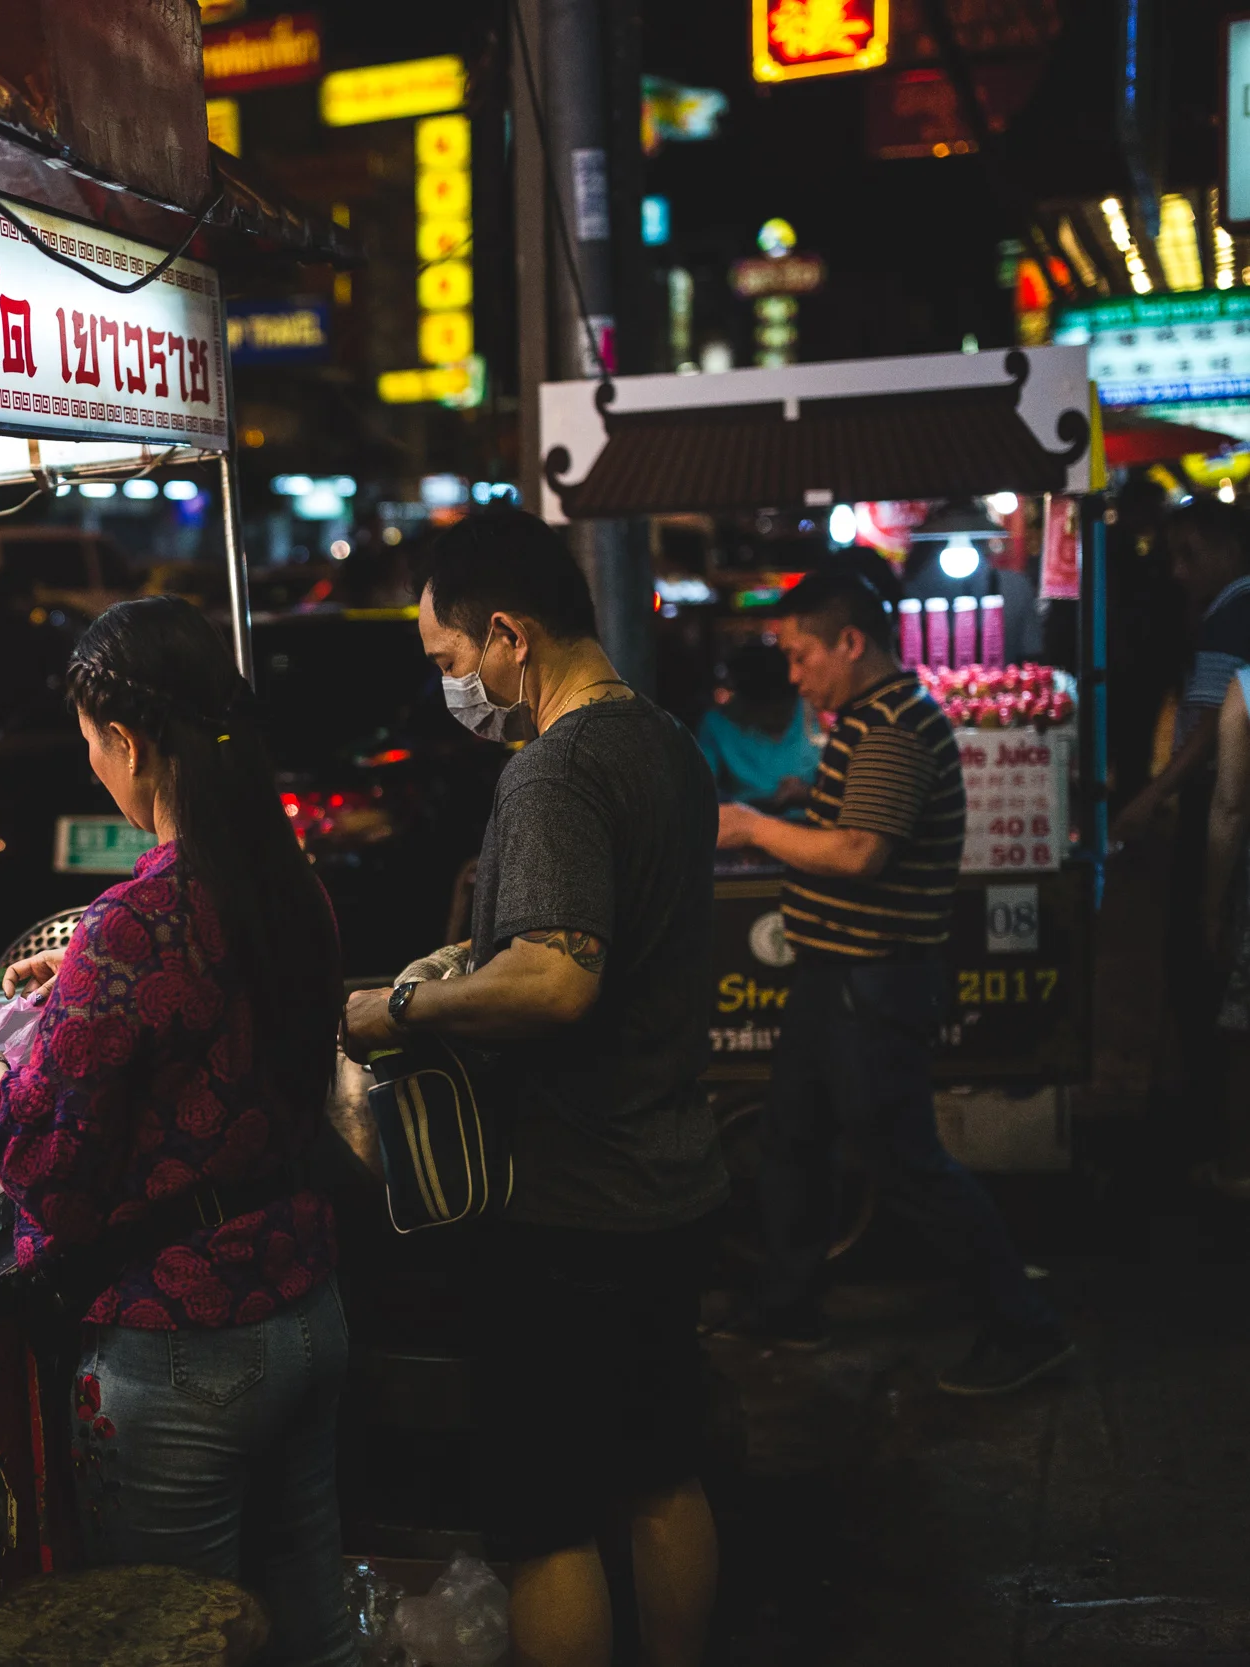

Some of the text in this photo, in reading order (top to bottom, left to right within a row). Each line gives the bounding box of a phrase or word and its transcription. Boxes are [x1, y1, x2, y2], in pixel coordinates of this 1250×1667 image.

[55, 307, 211, 405] เยาวราช
[995, 740, 1051, 767] Juice
[989, 814, 1051, 838] 40 B
[989, 842, 1026, 867] 50
[987, 900, 1037, 938] 08
[957, 968, 1059, 1003] 2017
